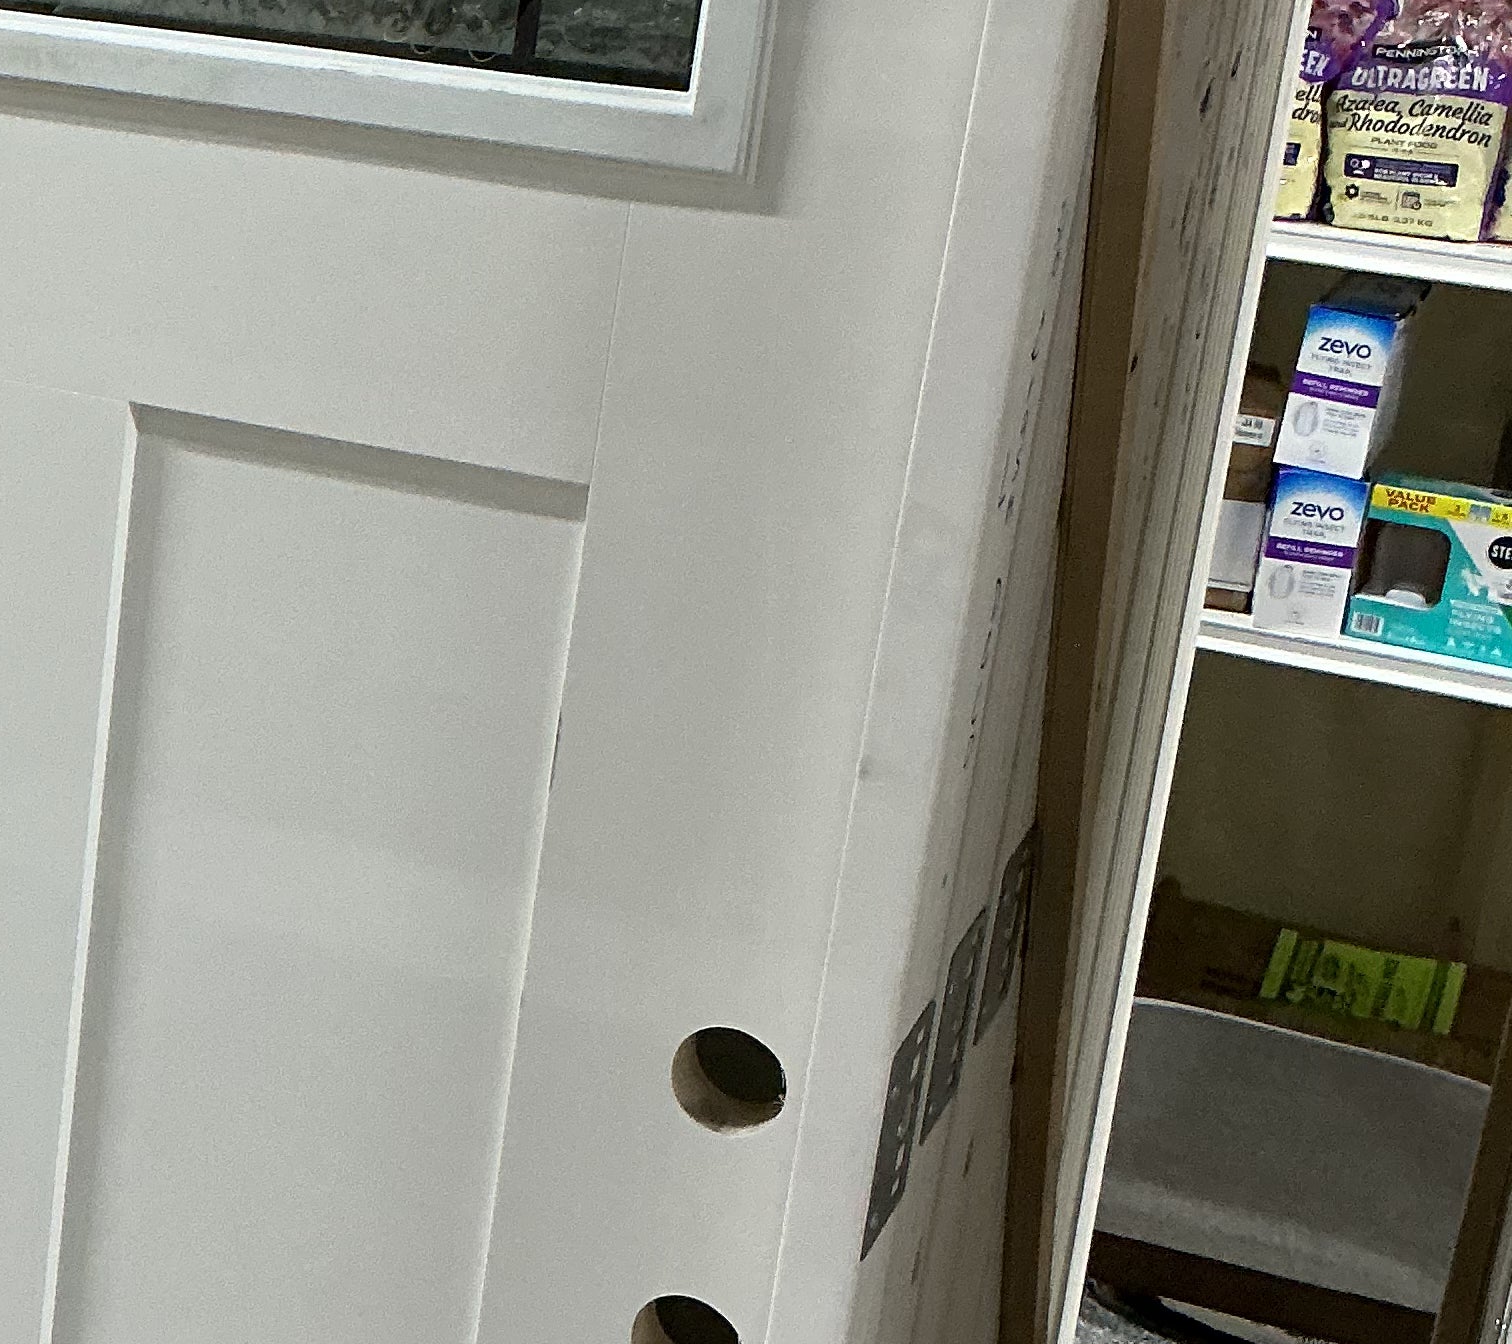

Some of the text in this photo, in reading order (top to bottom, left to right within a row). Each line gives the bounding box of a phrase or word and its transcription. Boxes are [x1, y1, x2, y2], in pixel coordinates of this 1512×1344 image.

[1351, 64, 1489, 92] ULTRAGREEN
[1407, 99, 1494, 126] Camellia
[1347, 112, 1493, 148] Rhododendron
[1318, 336, 1372, 359] zevo
[1386, 488, 1437, 505] VALUE
[1388, 498, 1430, 513] PACK
[1290, 501, 1345, 522] zevo
